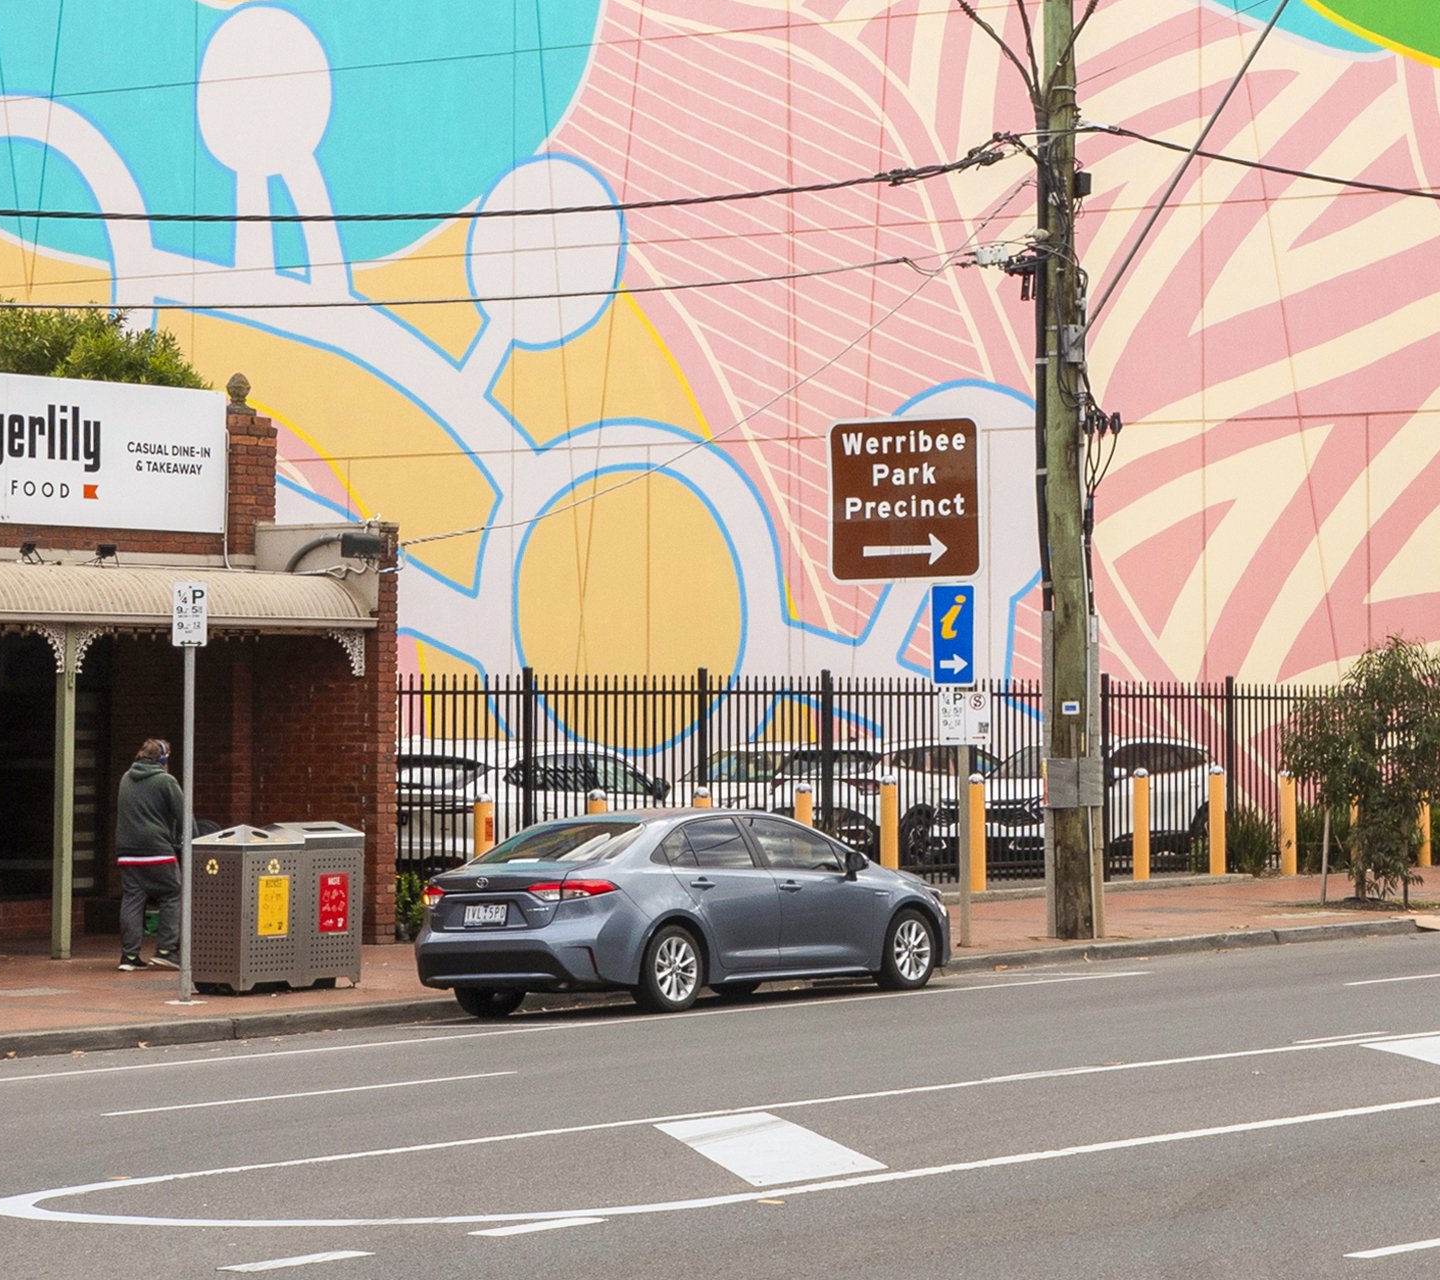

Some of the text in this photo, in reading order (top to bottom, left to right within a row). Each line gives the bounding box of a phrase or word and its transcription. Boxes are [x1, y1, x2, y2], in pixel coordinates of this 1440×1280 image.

[127, 441, 211, 459] CASUAL DINE-IN
[841, 430, 966, 456] Werribee
[135, 460, 203, 476] & TAKEAWAY
[872, 462, 936, 487] Park
[11, 480, 70, 498] FOOD
[845, 493, 965, 520] Precinct
[192, 589, 204, 604] P
[953, 693, 963, 705] P
